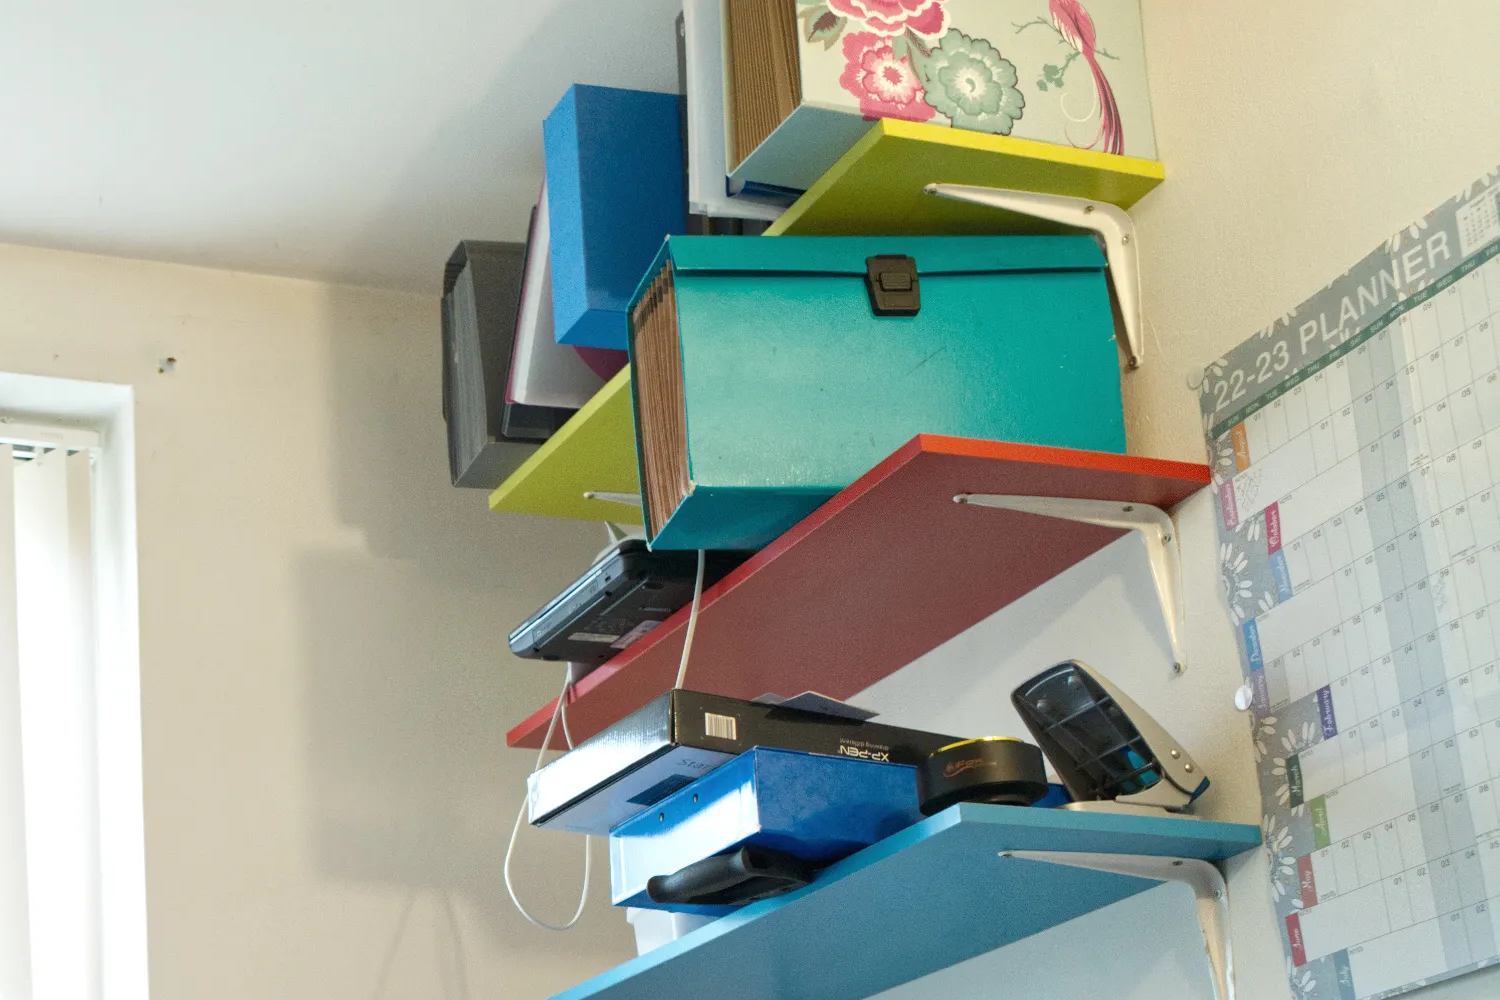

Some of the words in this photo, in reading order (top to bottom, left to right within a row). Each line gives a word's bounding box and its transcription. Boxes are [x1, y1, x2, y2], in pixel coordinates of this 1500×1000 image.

[1213, 340, 1290, 413] 22-23
[1299, 231, 1451, 355] PLANNER
[1245, 402, 1259, 414] MON
[1266, 389, 1278, 400] TUE
[1307, 364, 1320, 374] THU
[1329, 351, 1340, 361] FRI
[1461, 260, 1476, 272] THU
[1269, 509, 1280, 548] October
[1323, 690, 1335, 736] February
[840, 744, 890, 763] XP-PEN
[1290, 764, 1301, 797] March
[1315, 807, 1325, 834] April
[1302, 870, 1313, 893] May
[1292, 928, 1303, 951] June
